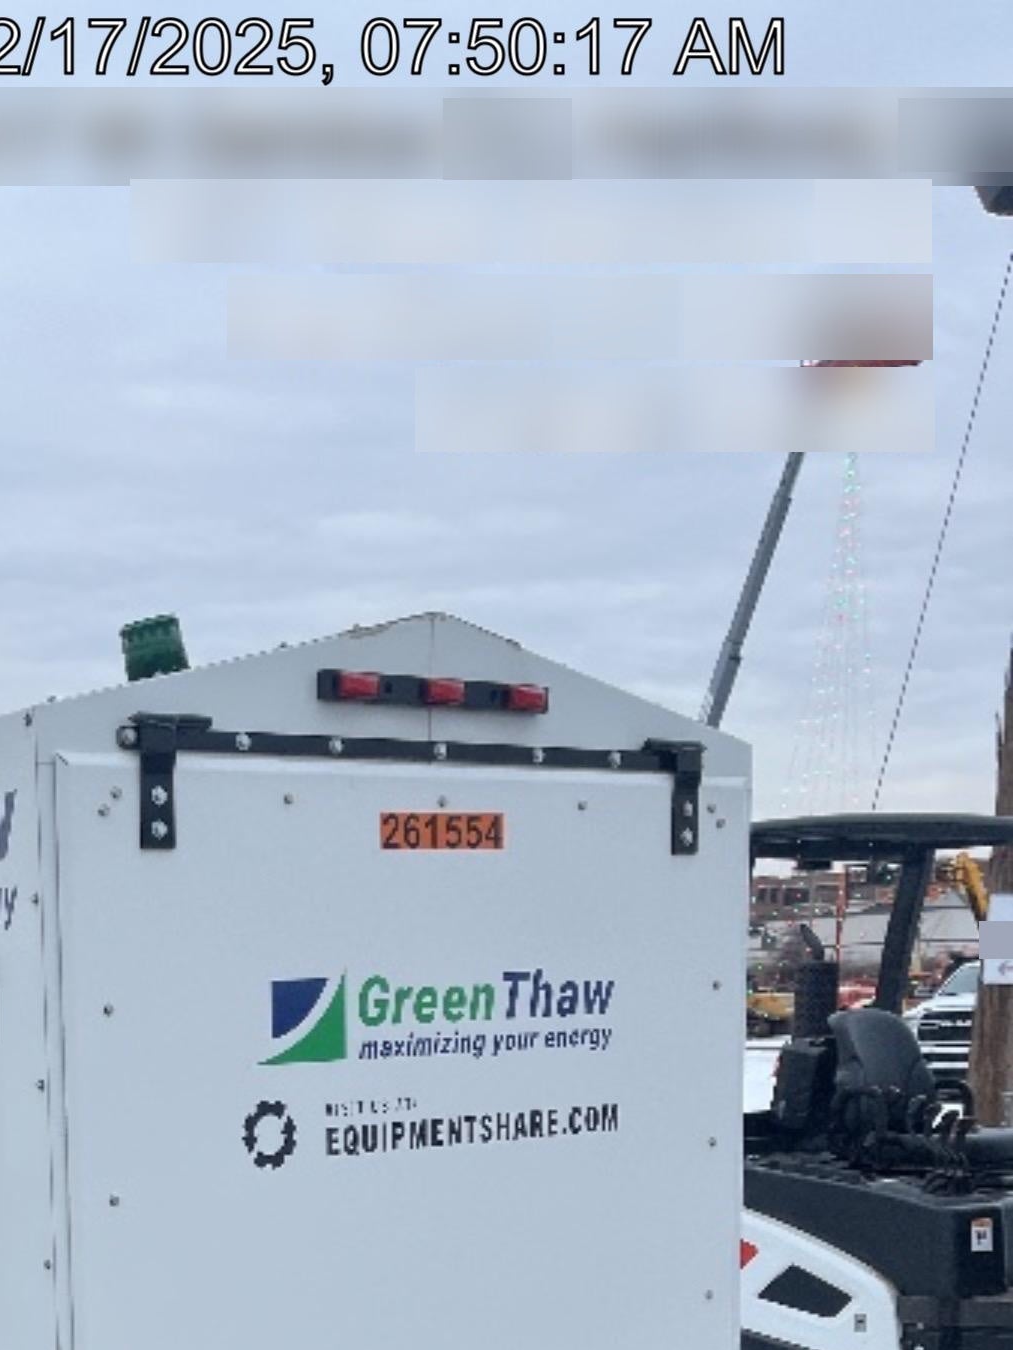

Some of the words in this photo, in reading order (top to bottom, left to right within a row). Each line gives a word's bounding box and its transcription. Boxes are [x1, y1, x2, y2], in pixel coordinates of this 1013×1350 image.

[381, 812, 504, 850] 261554
[358, 1030, 487, 1059] maximizing
[493, 1030, 540, 1056] your
[544, 1027, 613, 1051] energy
[325, 1103, 620, 1157] EQUIPMENTSHARE.COM
